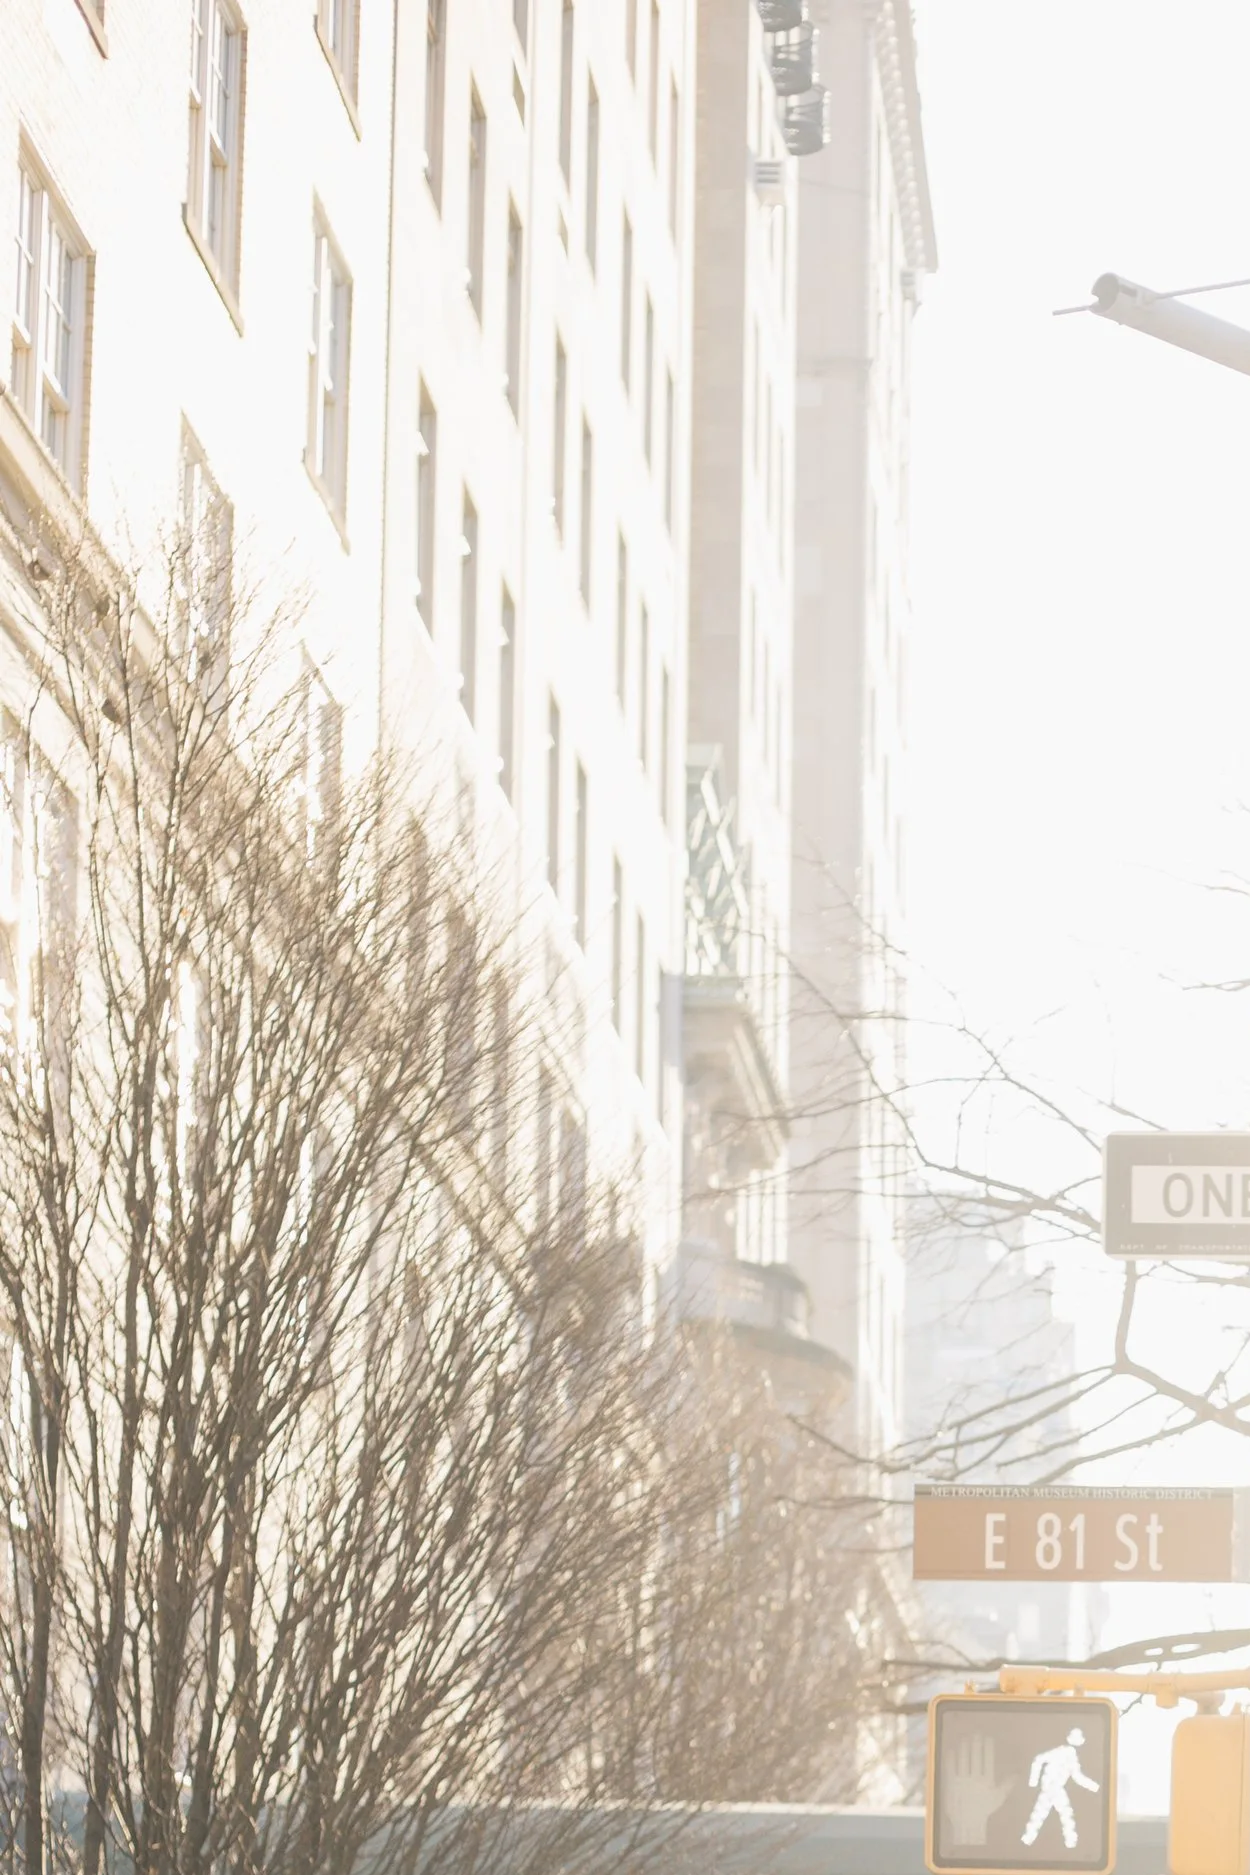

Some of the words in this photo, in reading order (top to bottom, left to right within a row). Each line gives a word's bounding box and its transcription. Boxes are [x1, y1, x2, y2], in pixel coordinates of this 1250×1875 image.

[930, 1486, 1030, 1498] METROPOLITAN
[1033, 1486, 1090, 1498] MUSEUM
[1093, 1487, 1150, 1500] HISTORIC
[1155, 1487, 1212, 1500] DISTRICT
[984, 1512, 1006, 1571] E
[1035, 1512, 1086, 1572] 81
[1114, 1512, 1164, 1572] St
